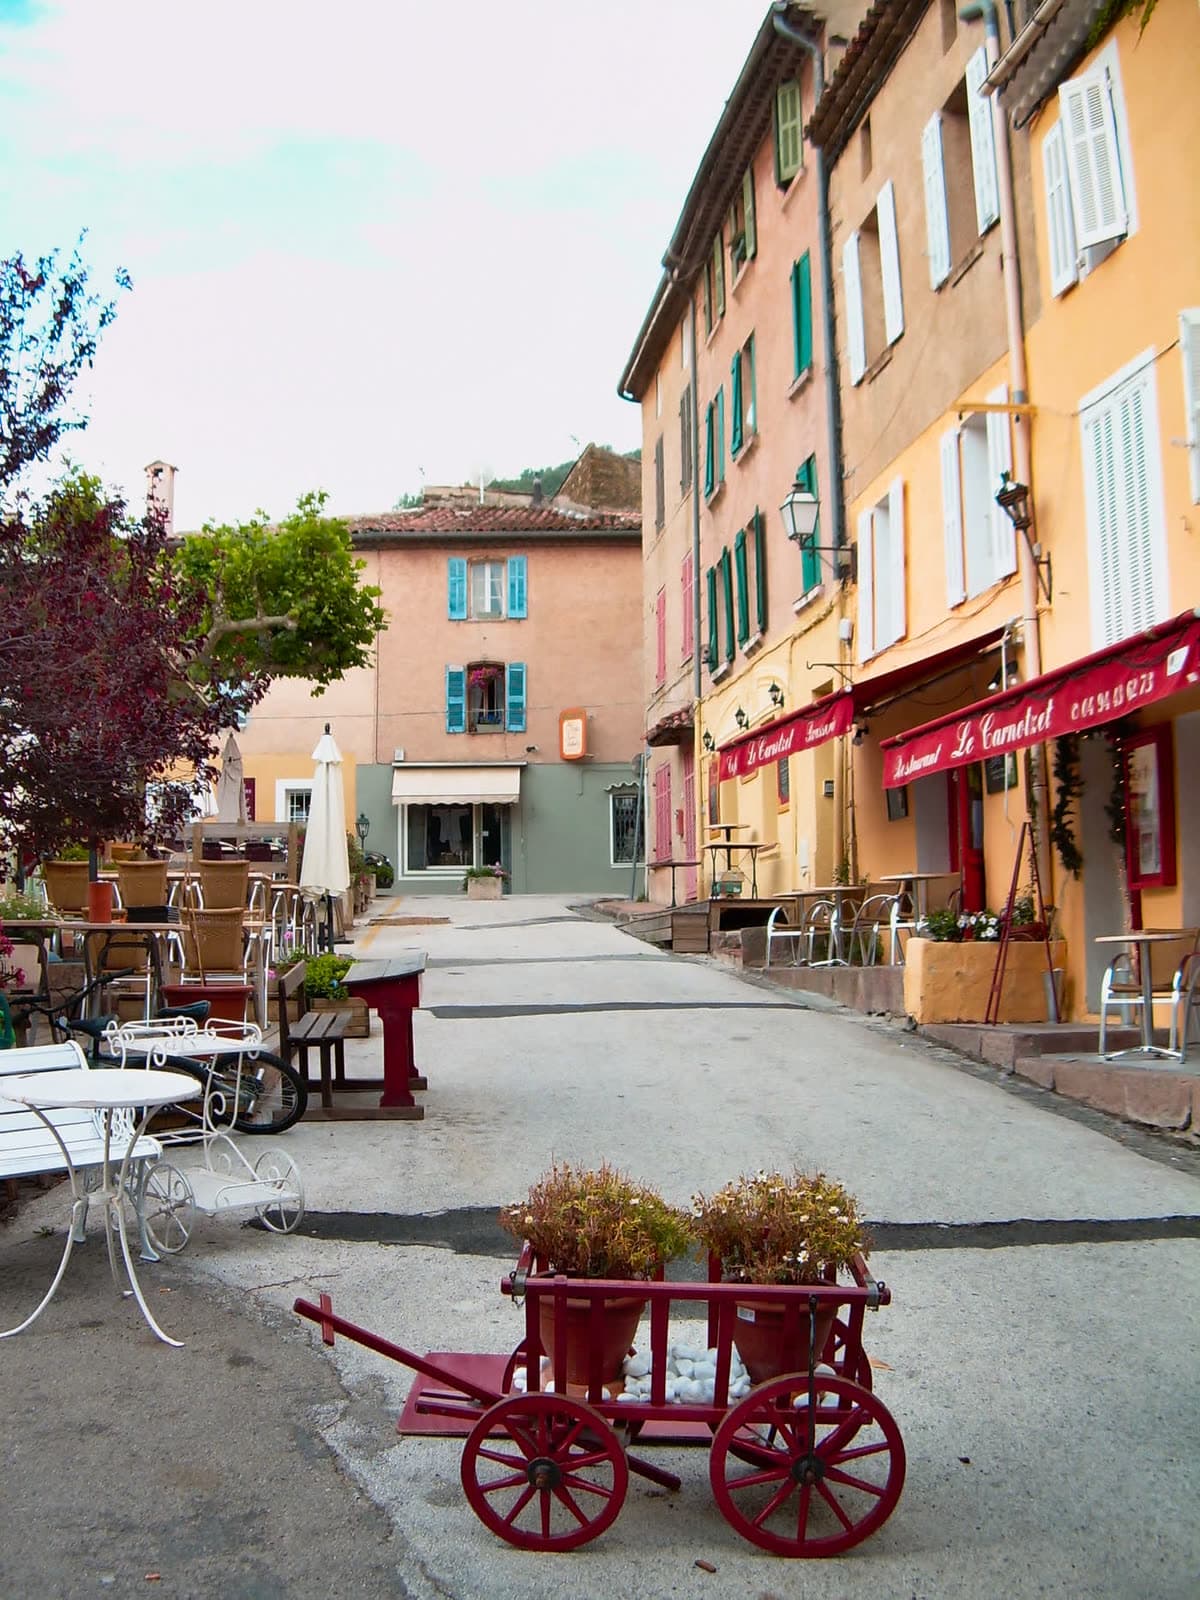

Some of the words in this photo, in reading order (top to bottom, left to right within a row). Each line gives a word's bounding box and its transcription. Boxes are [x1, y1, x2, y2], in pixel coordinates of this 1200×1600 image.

[893, 743, 943, 781] Restaurant
[951, 720, 975, 759] Le
[979, 698, 1054, 750] Carnotzet
[1081, 696, 1095, 718] 04
[1139, 671, 1155, 696] 73
